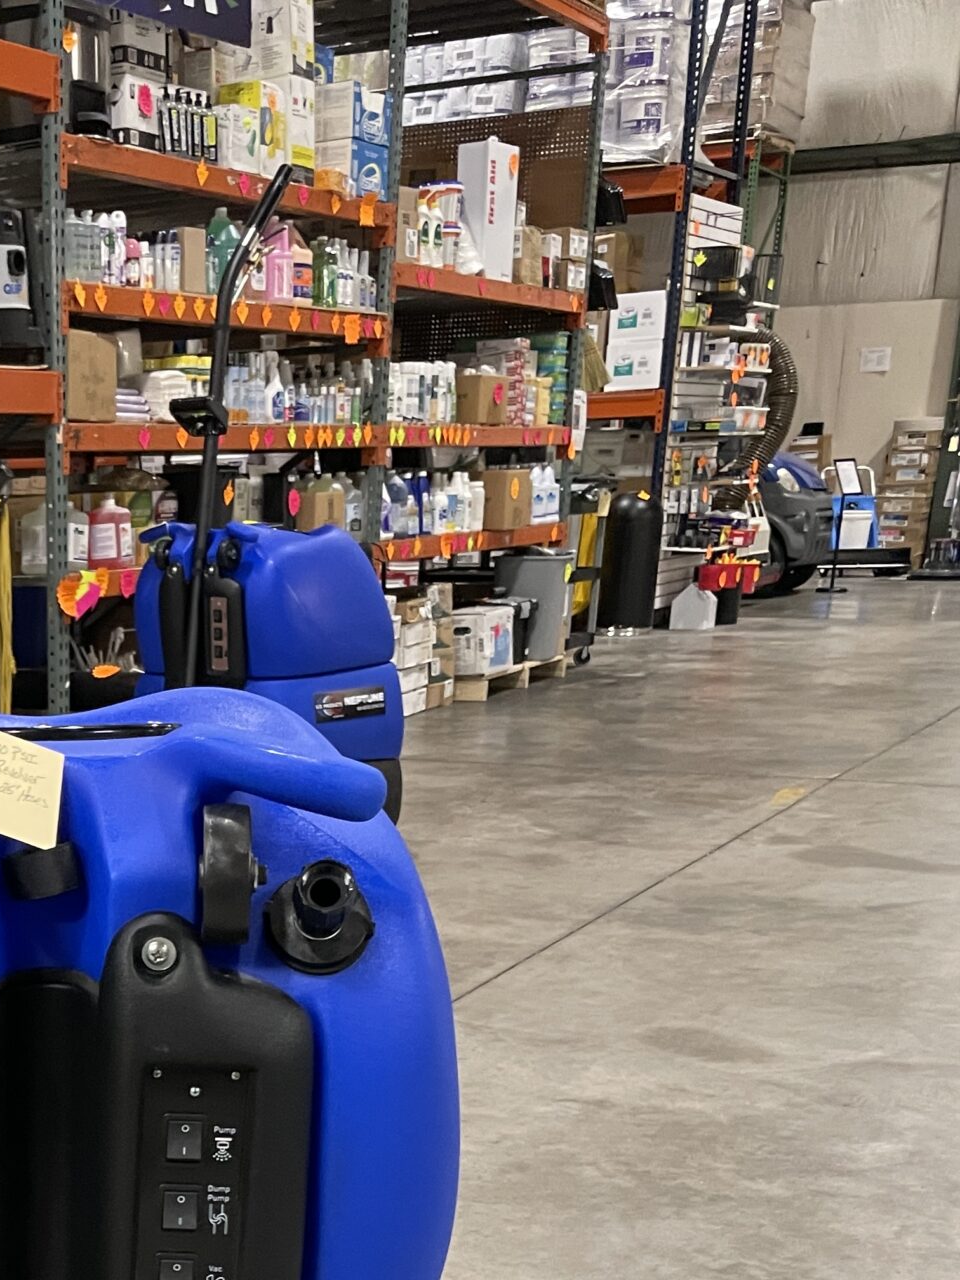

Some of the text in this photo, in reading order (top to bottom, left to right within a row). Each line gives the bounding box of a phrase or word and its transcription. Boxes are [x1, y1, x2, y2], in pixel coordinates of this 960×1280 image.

[213, 1125, 237, 1135] Pump
[207, 1184, 231, 1193] Dump
[207, 1194, 230, 1202] Pump
[208, 1265, 223, 1273] Vac
